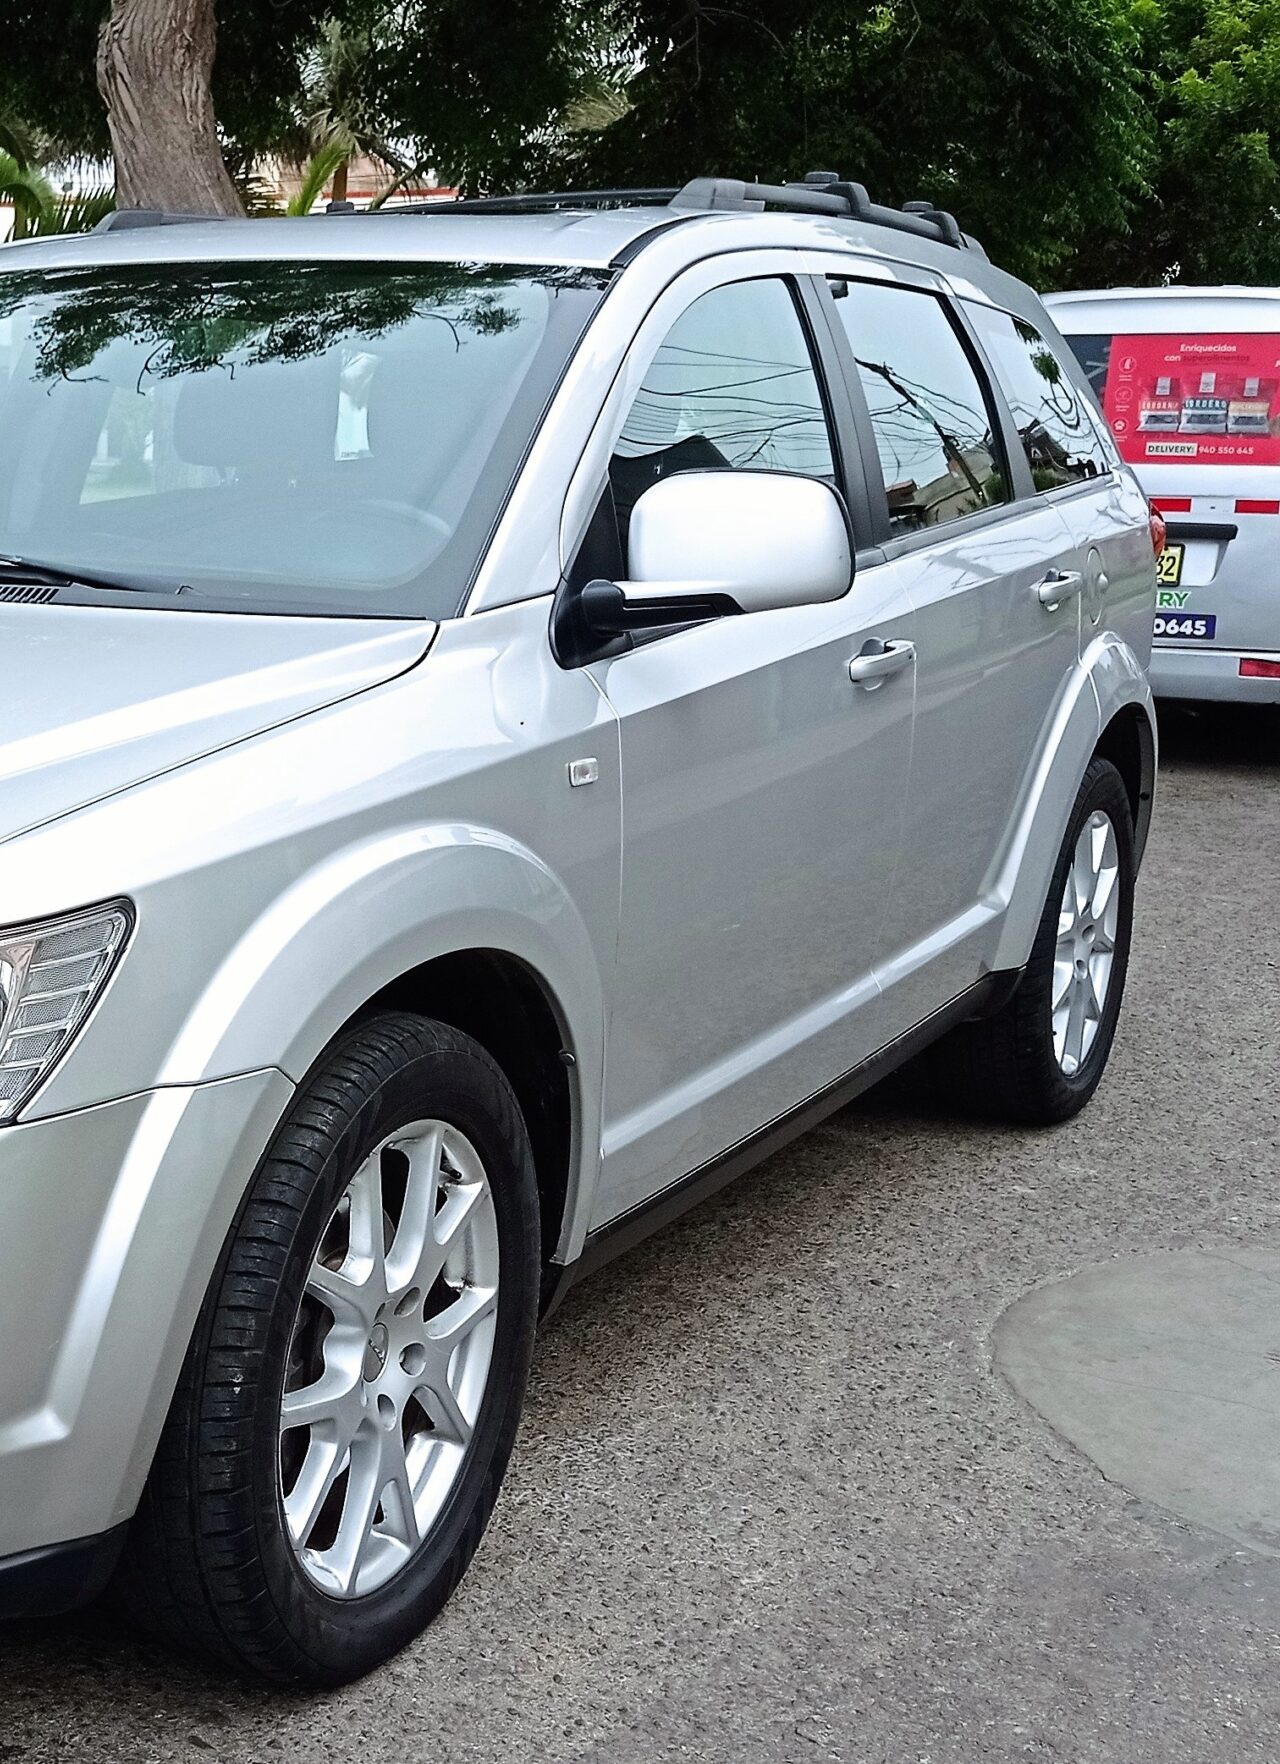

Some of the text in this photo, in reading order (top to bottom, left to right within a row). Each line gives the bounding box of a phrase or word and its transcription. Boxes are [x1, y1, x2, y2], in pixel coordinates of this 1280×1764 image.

[1180, 344, 1237, 353] Enriquecidos
[1148, 445, 1254, 455] DELIVERY: 940 550 645
